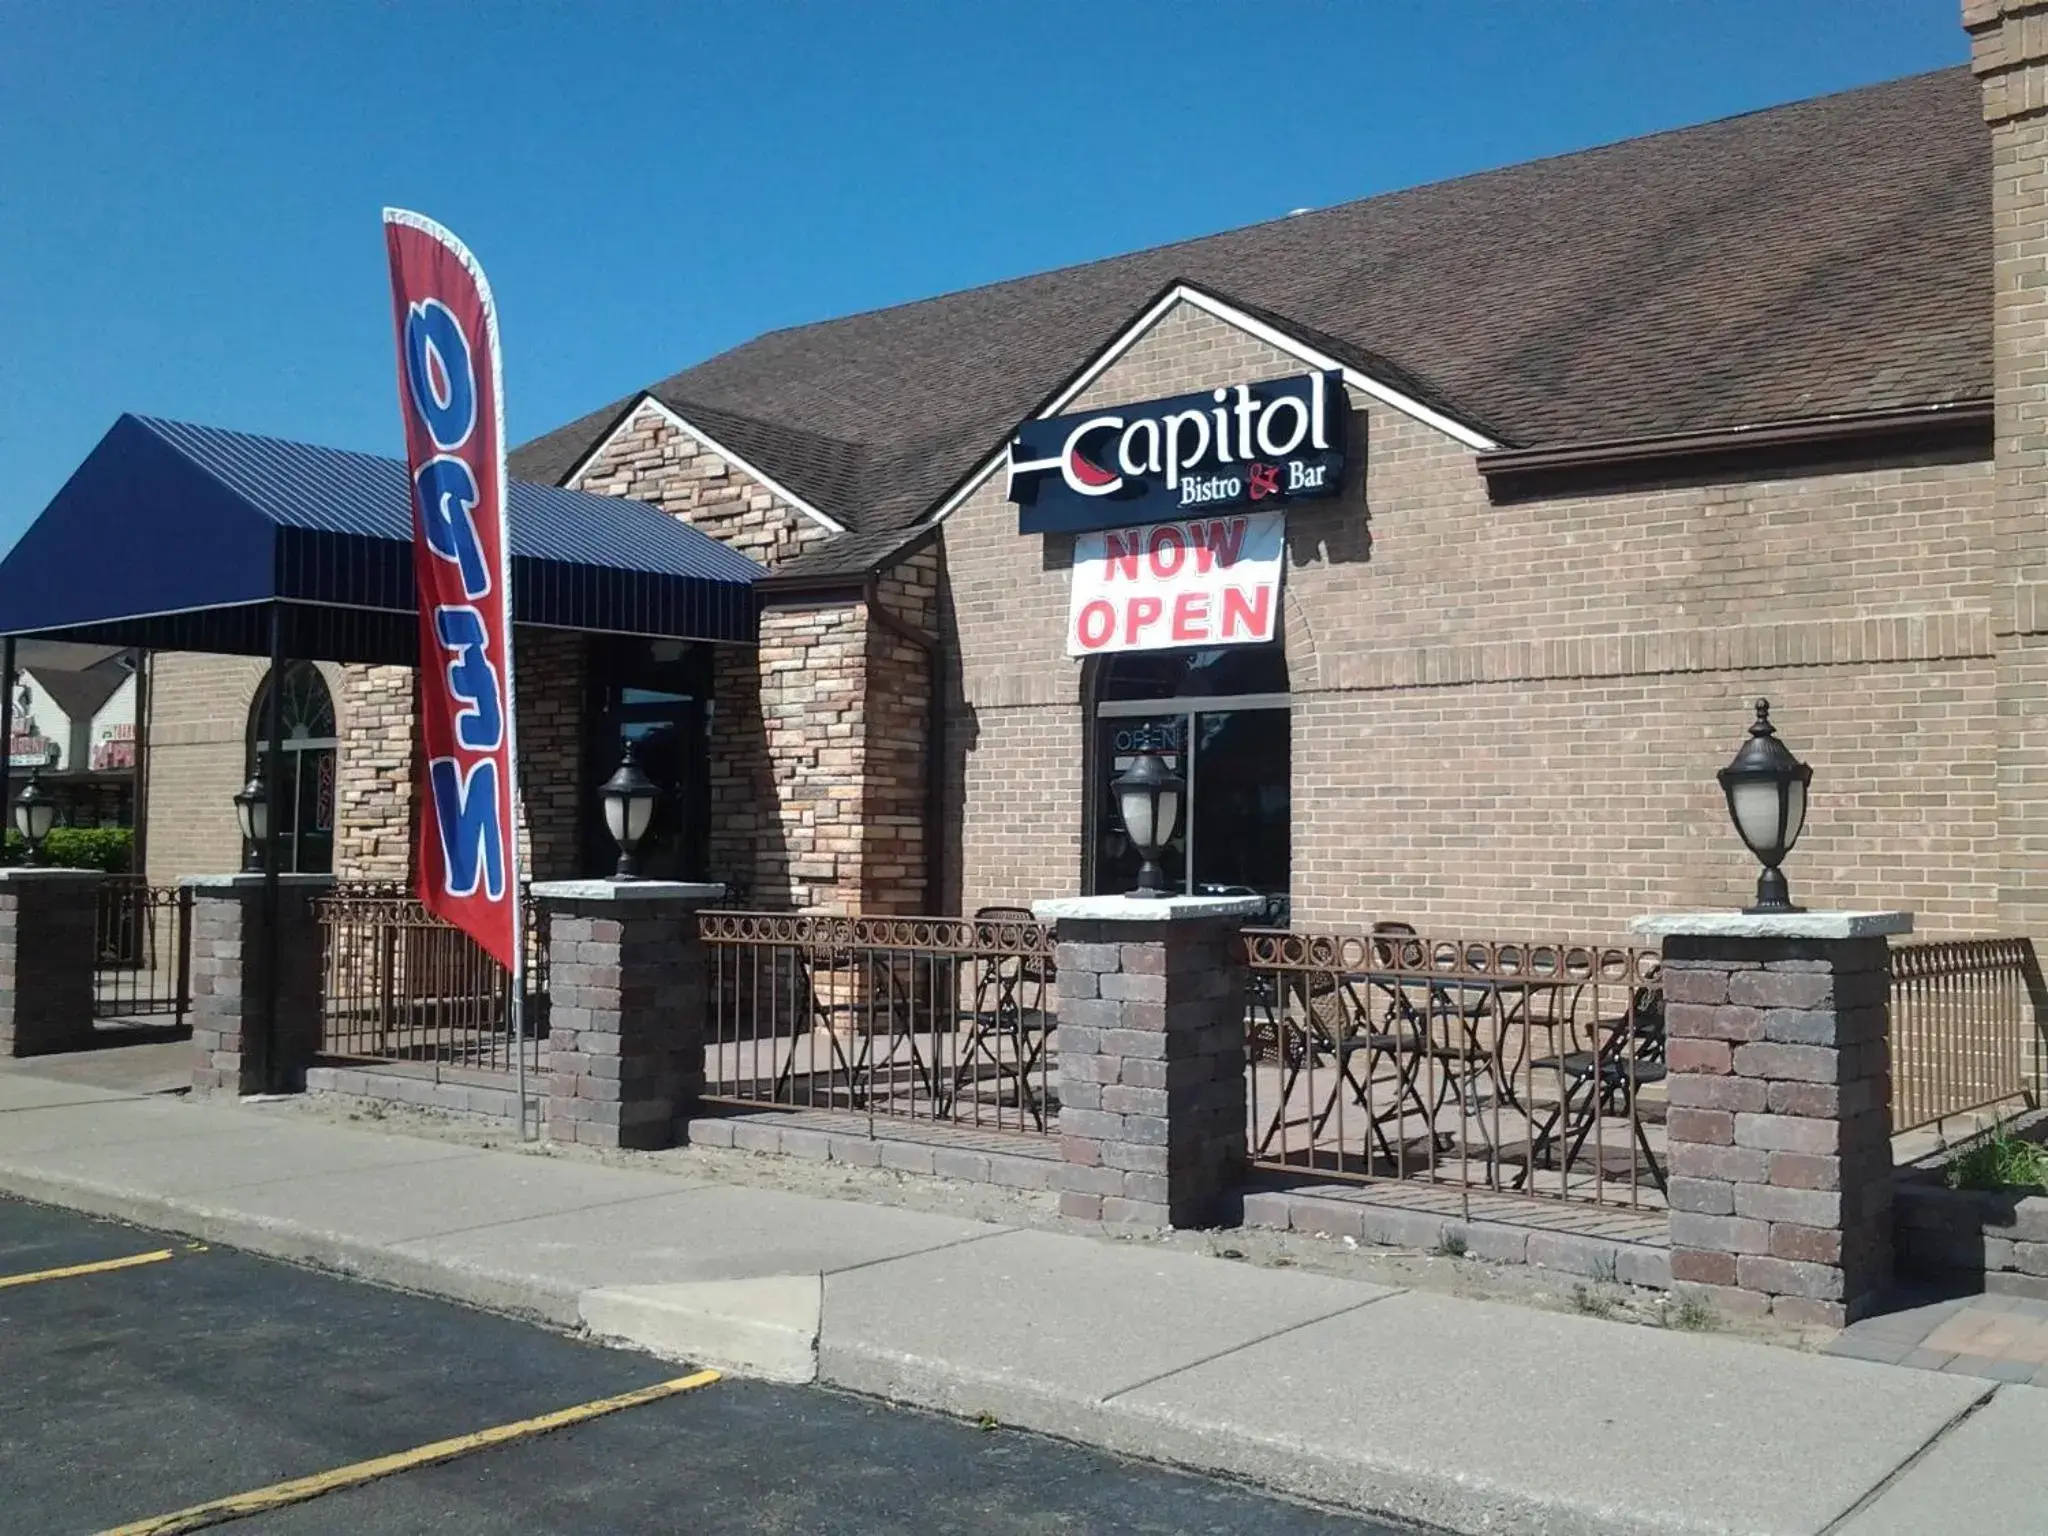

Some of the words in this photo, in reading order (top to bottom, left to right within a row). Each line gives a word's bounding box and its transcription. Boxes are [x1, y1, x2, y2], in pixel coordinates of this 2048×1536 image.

[1061, 372, 1329, 495] Capitol
[1179, 476, 1241, 504] Bistro
[1248, 463, 1280, 500] &
[1289, 461, 1326, 490] Bar
[1103, 518, 1249, 583] NOW
[1076, 585, 1271, 649] OPEN
